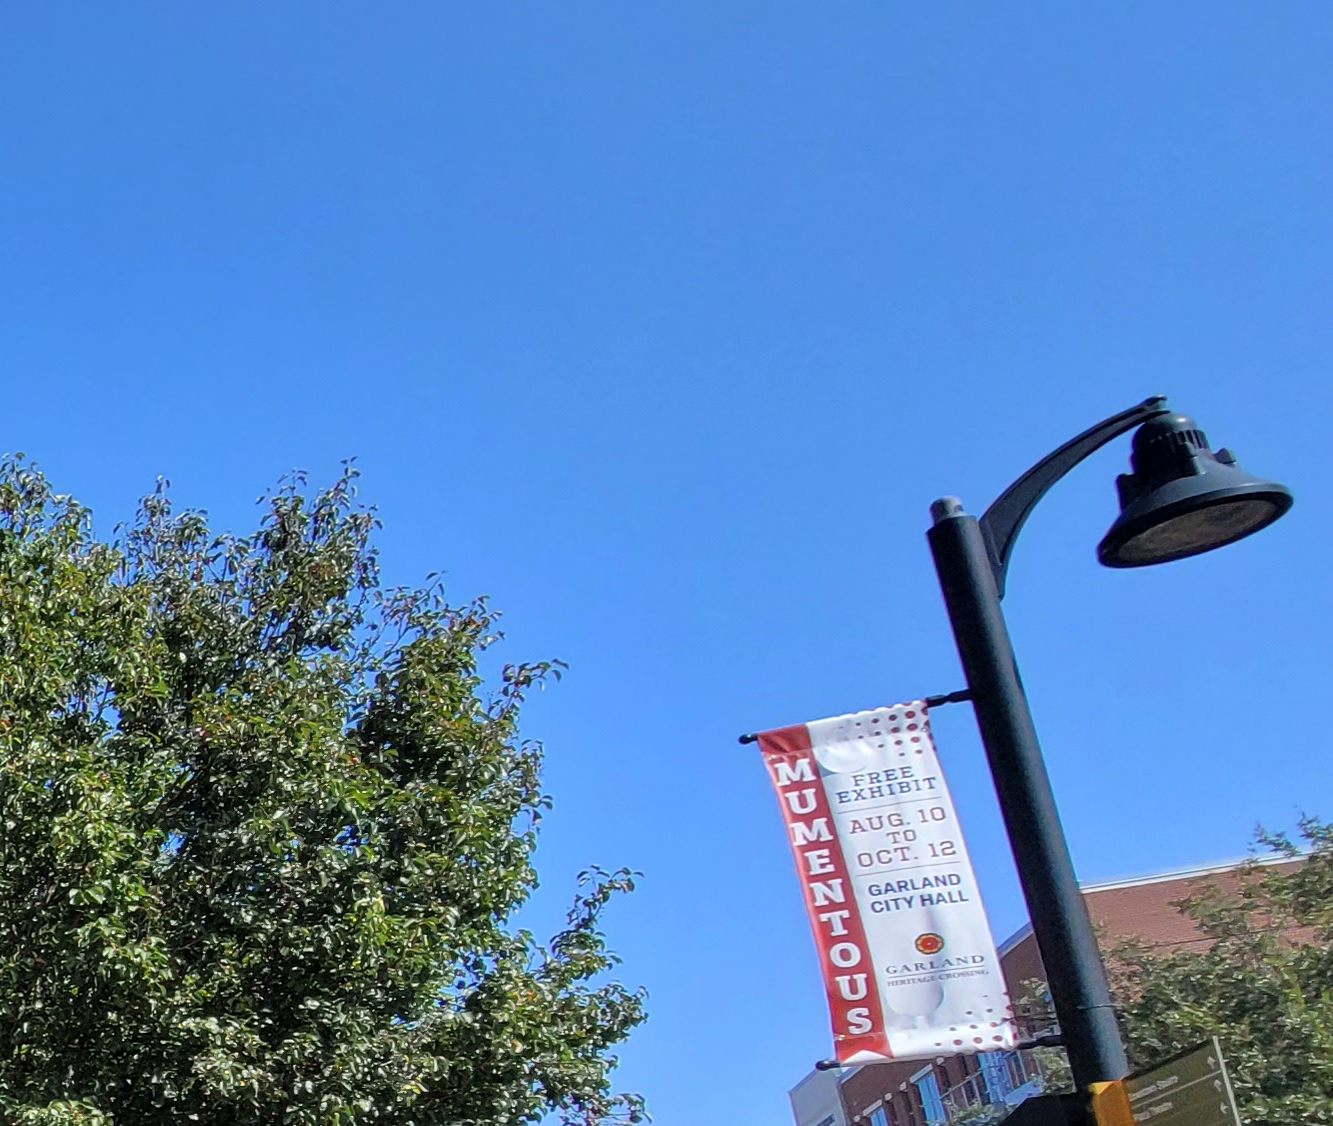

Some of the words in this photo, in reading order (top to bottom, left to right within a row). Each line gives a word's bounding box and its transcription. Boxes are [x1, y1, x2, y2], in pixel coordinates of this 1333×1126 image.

[851, 765, 915, 787] FREE
[836, 776, 937, 804] EXHIBIT
[849, 812, 912, 835] AUG.
[917, 806, 947, 824] 10
[886, 829, 918, 845] TO
[856, 845, 920, 868] OCT.
[927, 840, 958, 858] 12
[777, 757, 874, 1035] MUMENTOUS
[867, 873, 962, 897] GARLAND
[870, 895, 915, 914] CITY
[919, 889, 970, 908] HALL
[885, 955, 986, 975] GARLAND
